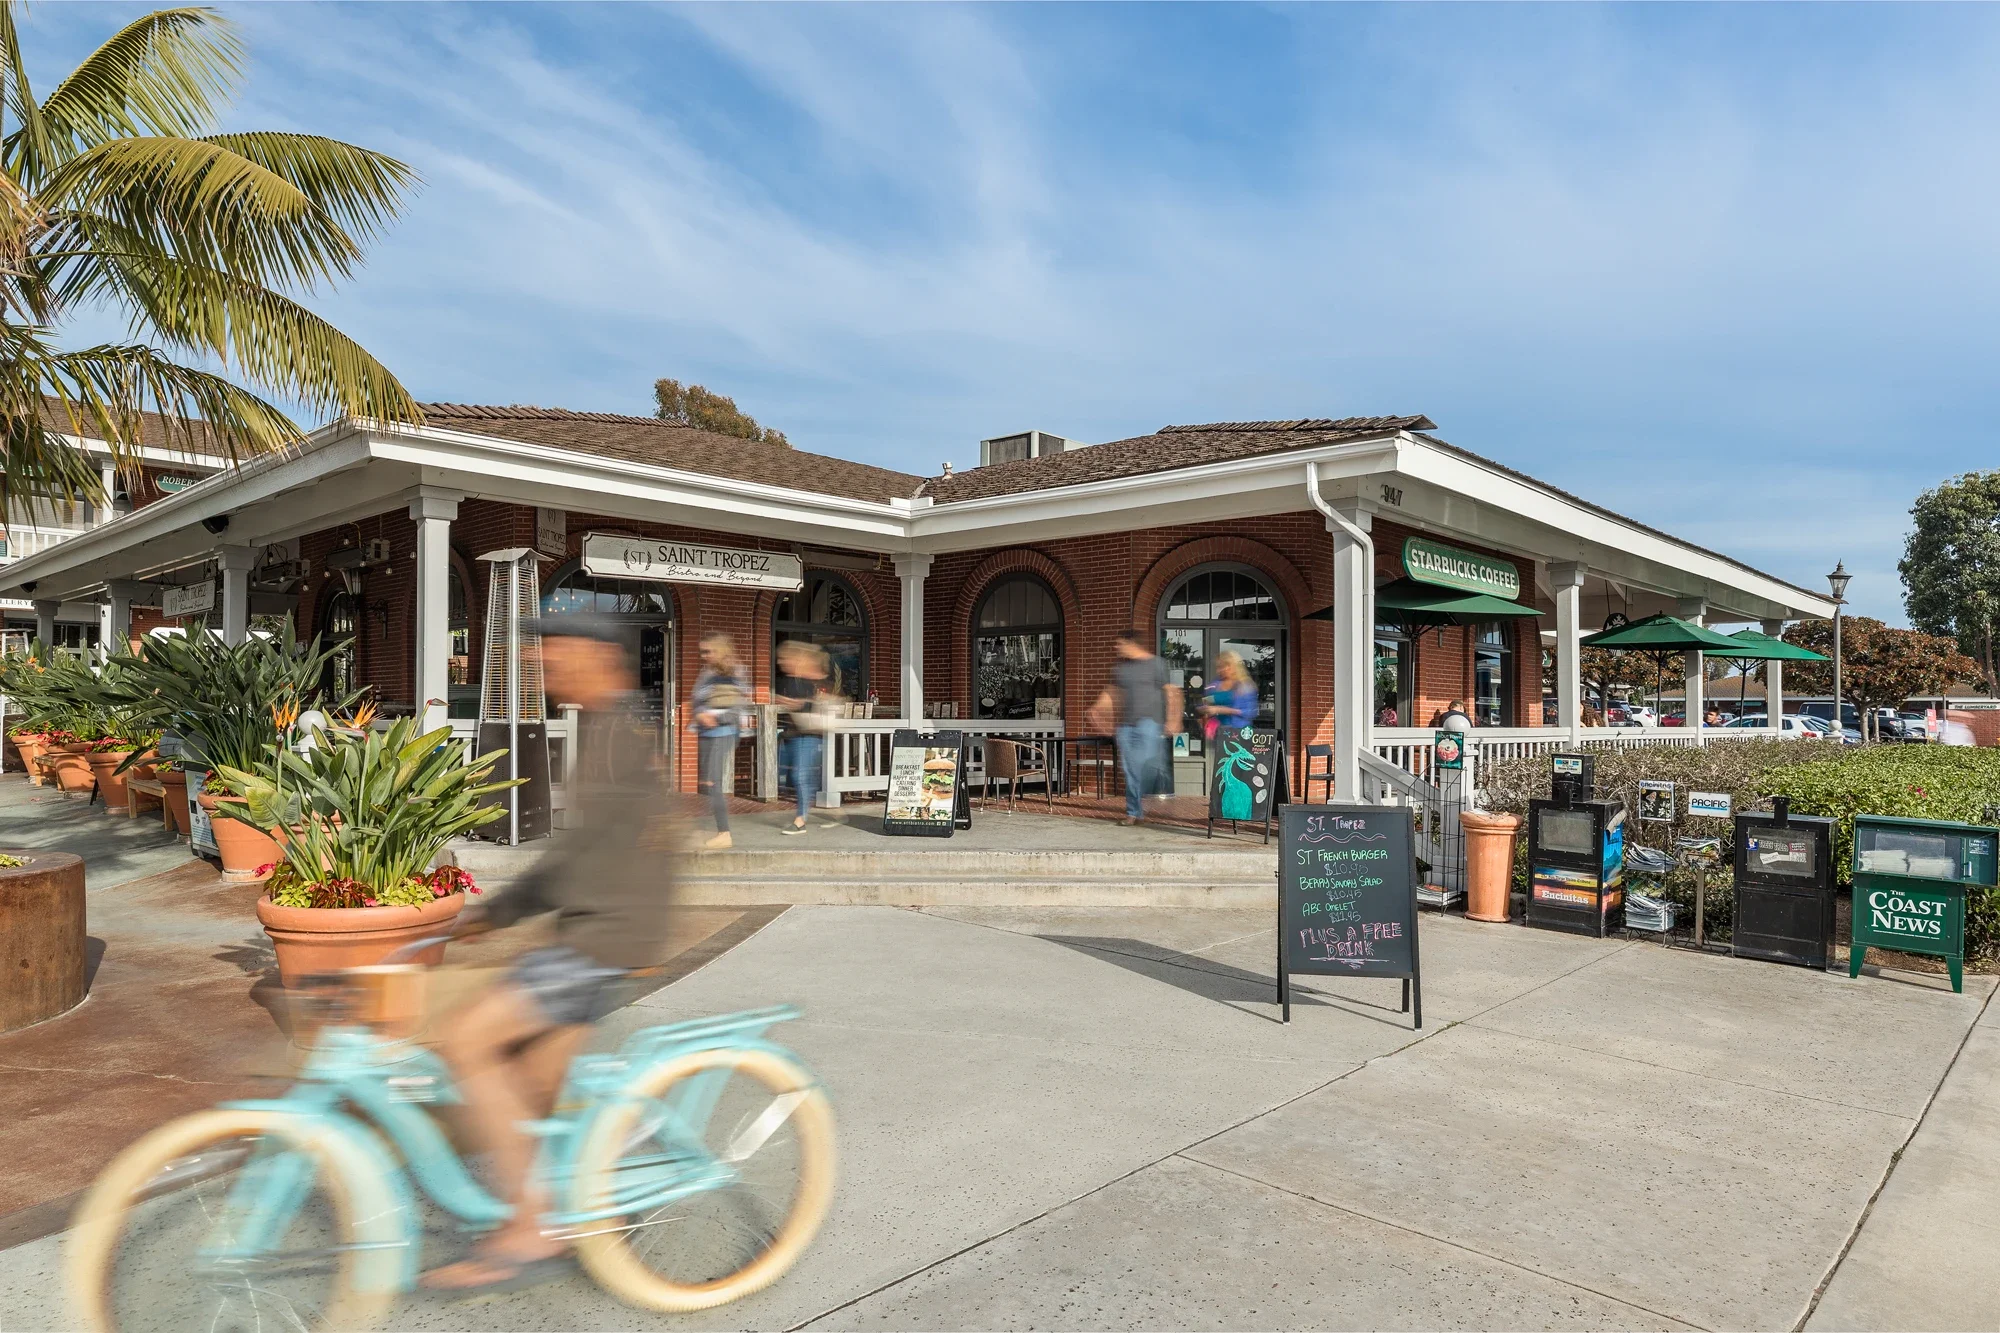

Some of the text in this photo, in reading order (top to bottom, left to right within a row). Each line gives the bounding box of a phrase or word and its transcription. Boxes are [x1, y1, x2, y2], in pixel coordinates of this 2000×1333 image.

[1384, 484, 1403, 507] 947
[630, 550, 646, 565] ST
[658, 545, 770, 572] SAINT TROPEZ
[665, 564, 763, 585] Bistro and Beyond
[1410, 548, 1516, 590] STARBUCKS COFFEE
[1174, 629, 1187, 637] 101
[1174, 735, 1186, 748] A
[1252, 733, 1274, 745] GOT
[1691, 798, 1728, 808] PACIFIC
[1306, 815, 1326, 833] ST.
[1296, 848, 1388, 865] ST FRENCH BURGER
[1299, 876, 1330, 891] BERRY
[1359, 875, 1383, 887] SALAD
[1541, 889, 1589, 905] Encinitas
[1889, 889, 1906, 897] THE
[1302, 900, 1356, 917] ABC OMELET
[1868, 891, 1947, 917] COAST
[1871, 909, 1941, 935] NEWS
[1300, 921, 1403, 949] PLUS A FREE
[1326, 940, 1375, 958] DRINK
